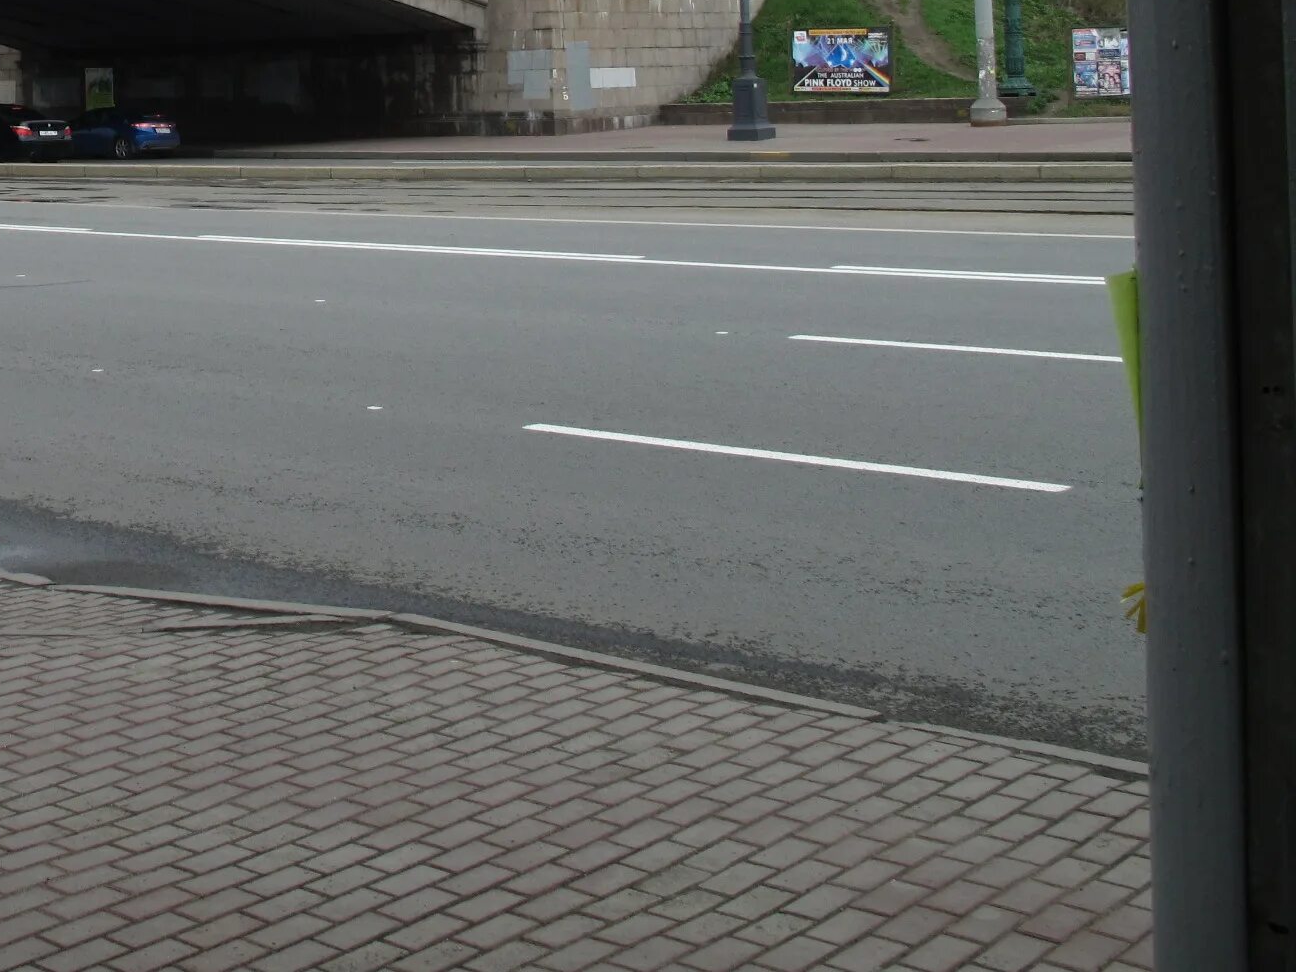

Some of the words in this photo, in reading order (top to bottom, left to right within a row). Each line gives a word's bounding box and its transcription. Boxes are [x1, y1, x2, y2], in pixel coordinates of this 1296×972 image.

[804, 79, 825, 87] PINK
[826, 78, 854, 87] FLOYD
[853, 79, 877, 87] SHOW
